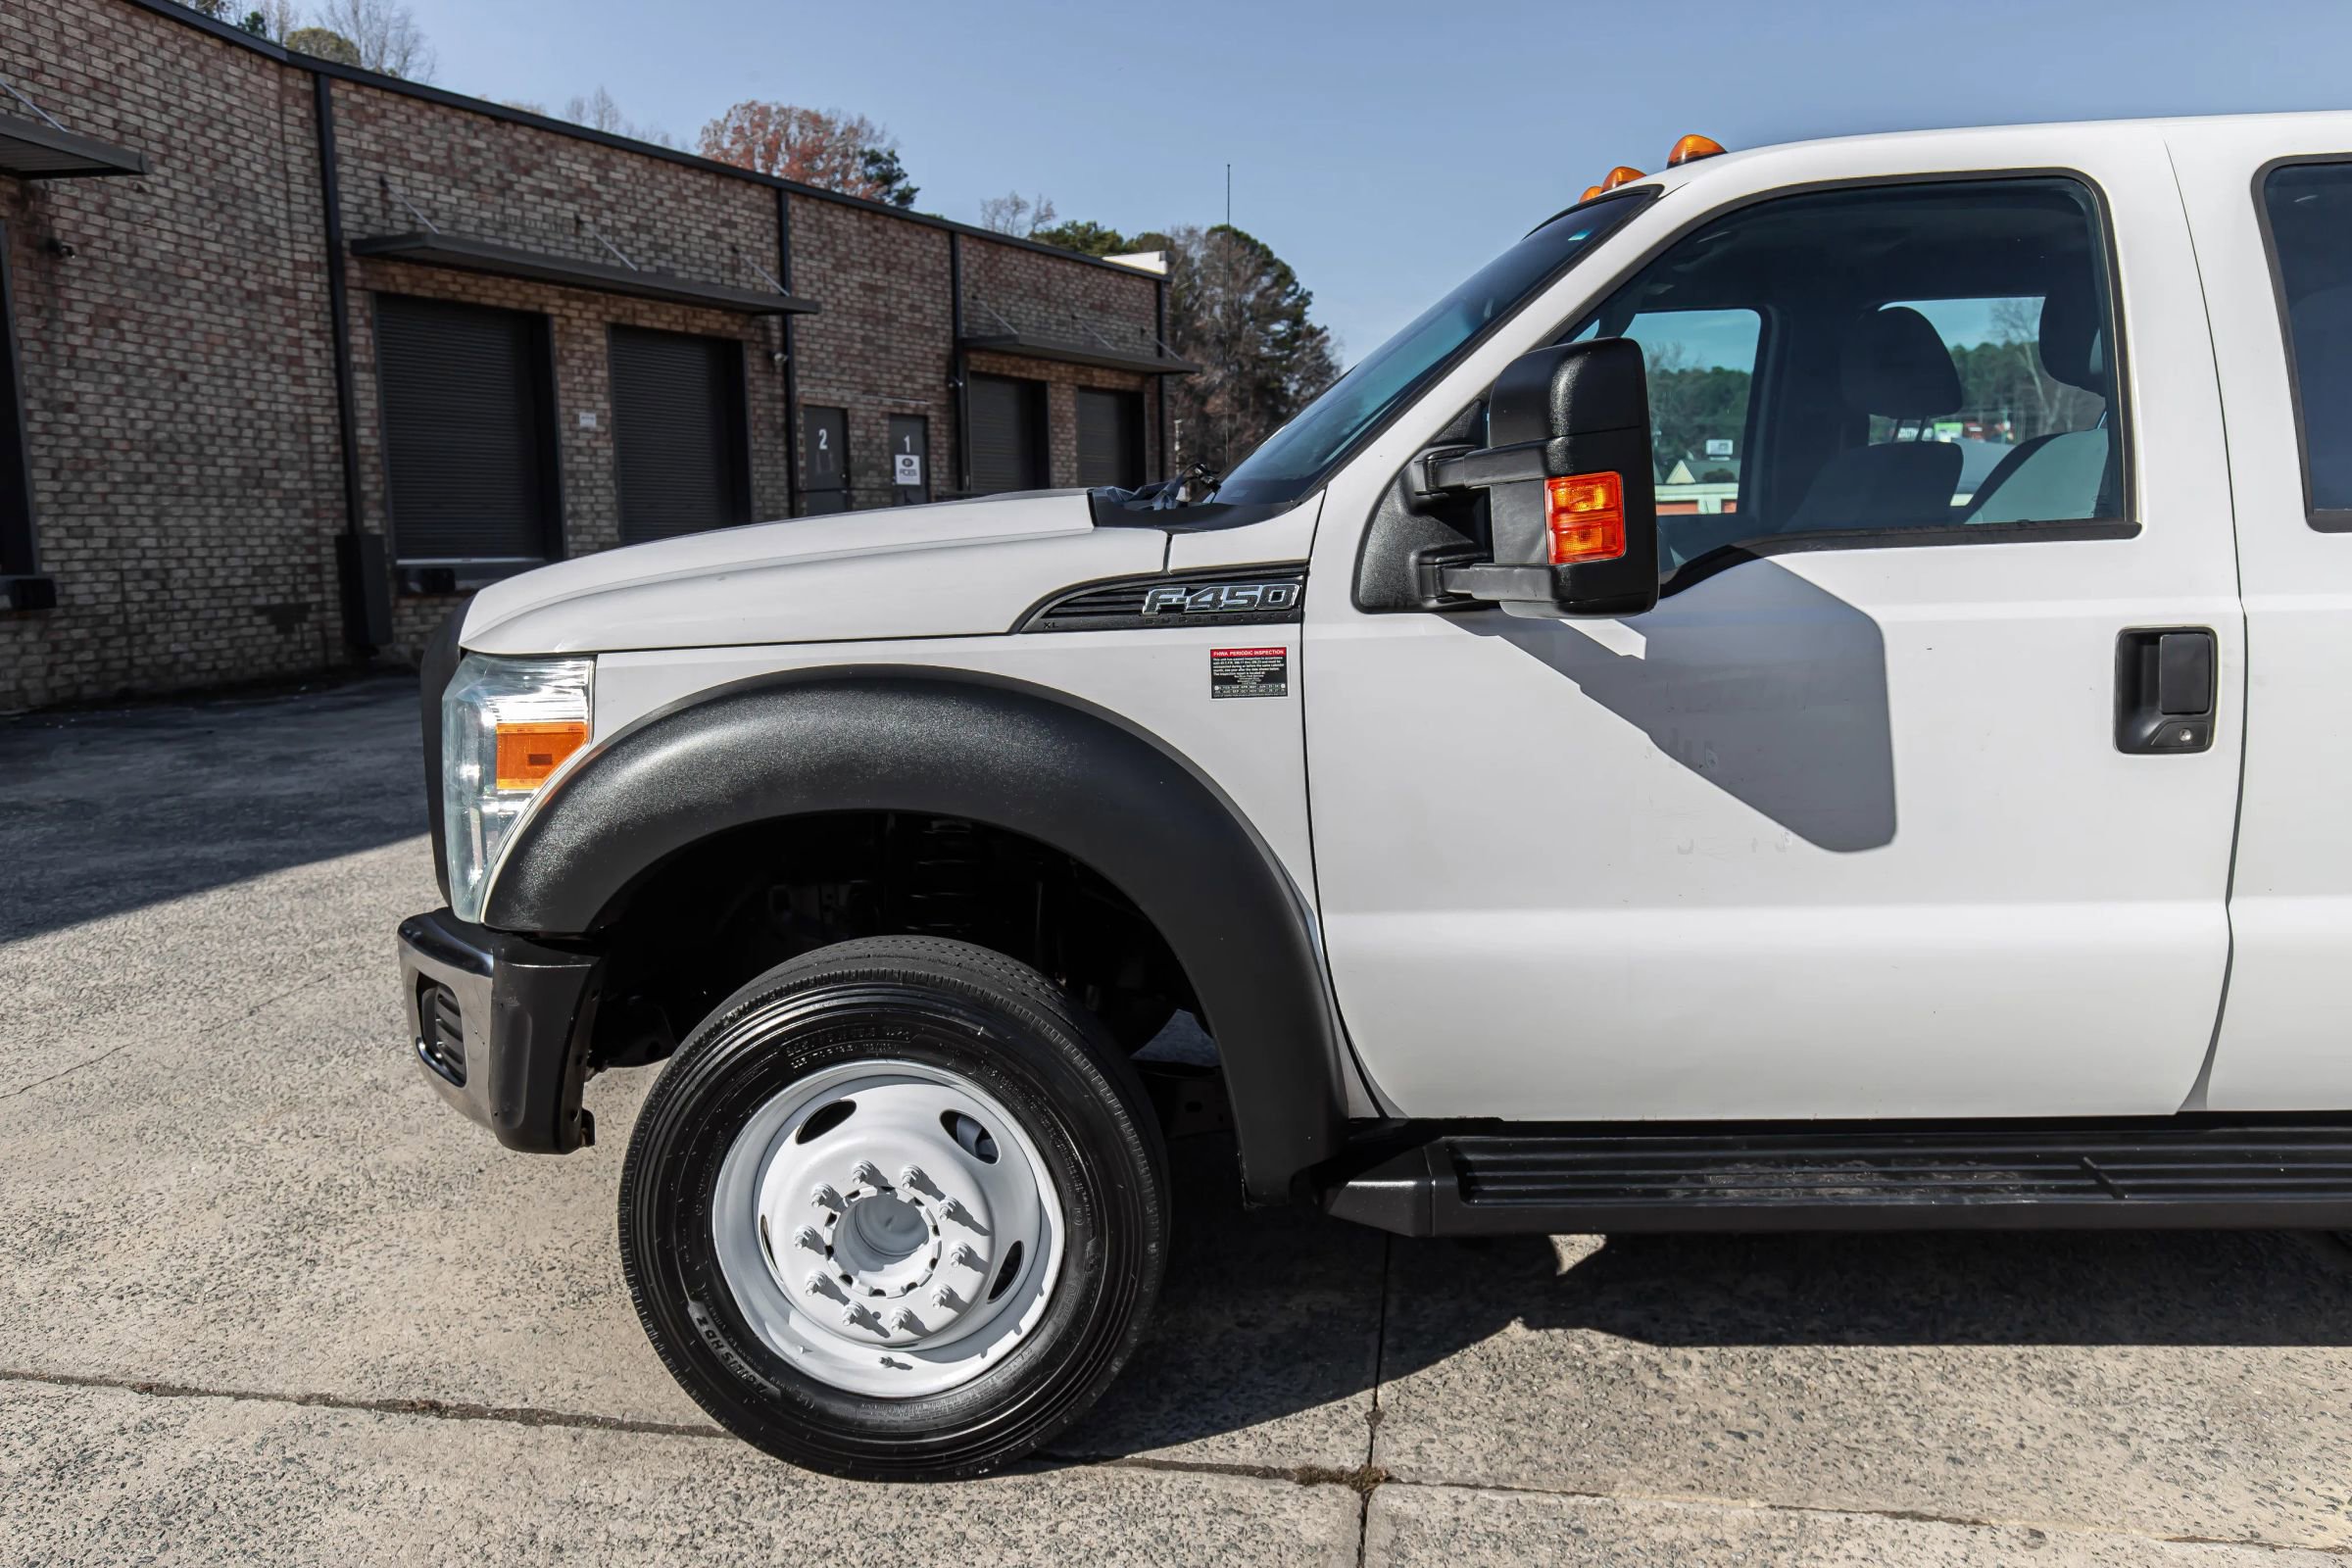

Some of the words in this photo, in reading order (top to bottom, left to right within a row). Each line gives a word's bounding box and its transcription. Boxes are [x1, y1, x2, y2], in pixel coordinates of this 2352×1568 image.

[818, 428, 828, 450] 2
[904, 435, 910, 453] 1
[1142, 584, 1300, 616] F-450
